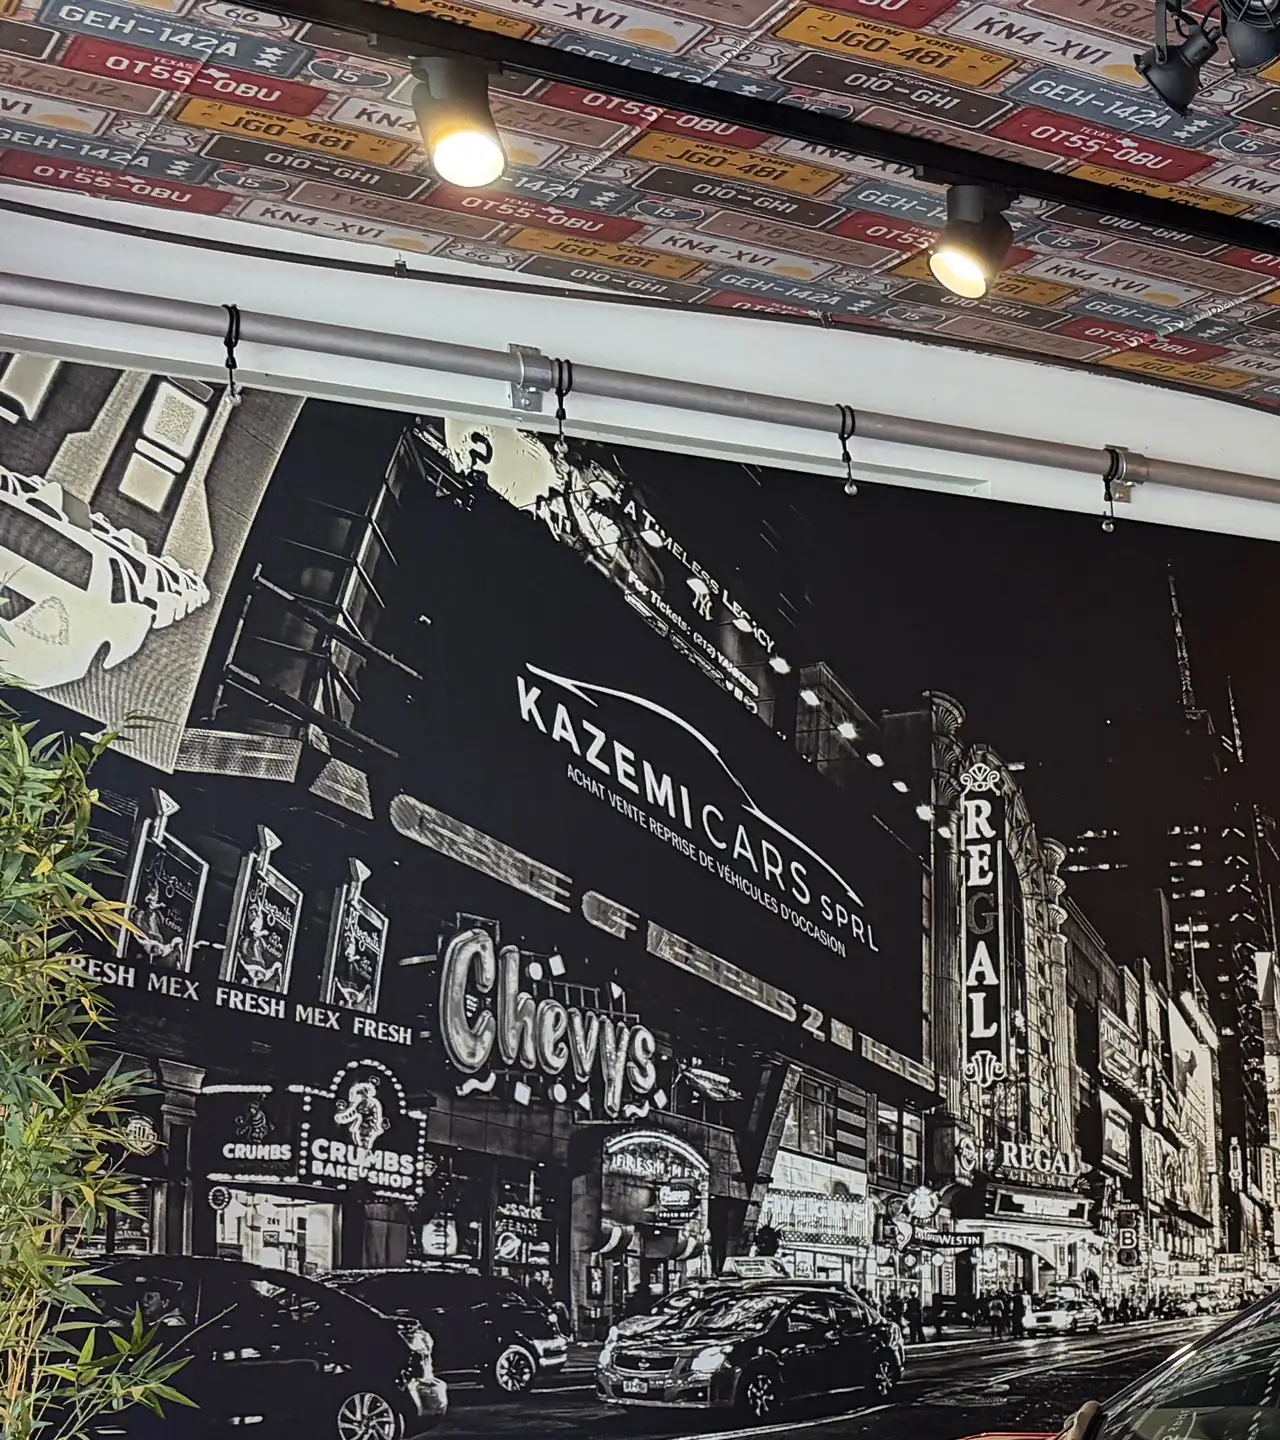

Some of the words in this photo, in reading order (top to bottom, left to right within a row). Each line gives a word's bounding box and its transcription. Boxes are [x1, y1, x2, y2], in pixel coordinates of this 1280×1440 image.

[516, 675, 693, 830] KAZEMI
[702, 804, 811, 905] CARS
[820, 895, 879, 952] SPRL
[567, 764, 606, 800] ACHAT
[607, 788, 647, 829] VENTE
[649, 817, 698, 861] REPRISE
[699, 850, 715, 873] DE
[716, 856, 779, 915] VÉHICULES
[781, 907, 847, 959] D'OCCASION
[964, 799, 998, 1041] REGAL
[147, 972, 200, 1001] MEX
[215, 987, 286, 1019] FRESH
[295, 1003, 342, 1031] MEX
[352, 1017, 413, 1046] FRESH
[222, 1142, 293, 1162] CRUMBS
[311, 1138, 415, 1175] CRUMBS
[311, 1160, 358, 1183] BAKE
[368, 1171, 414, 1189] SHOP
[1001, 1141, 1081, 1174] REGAL
